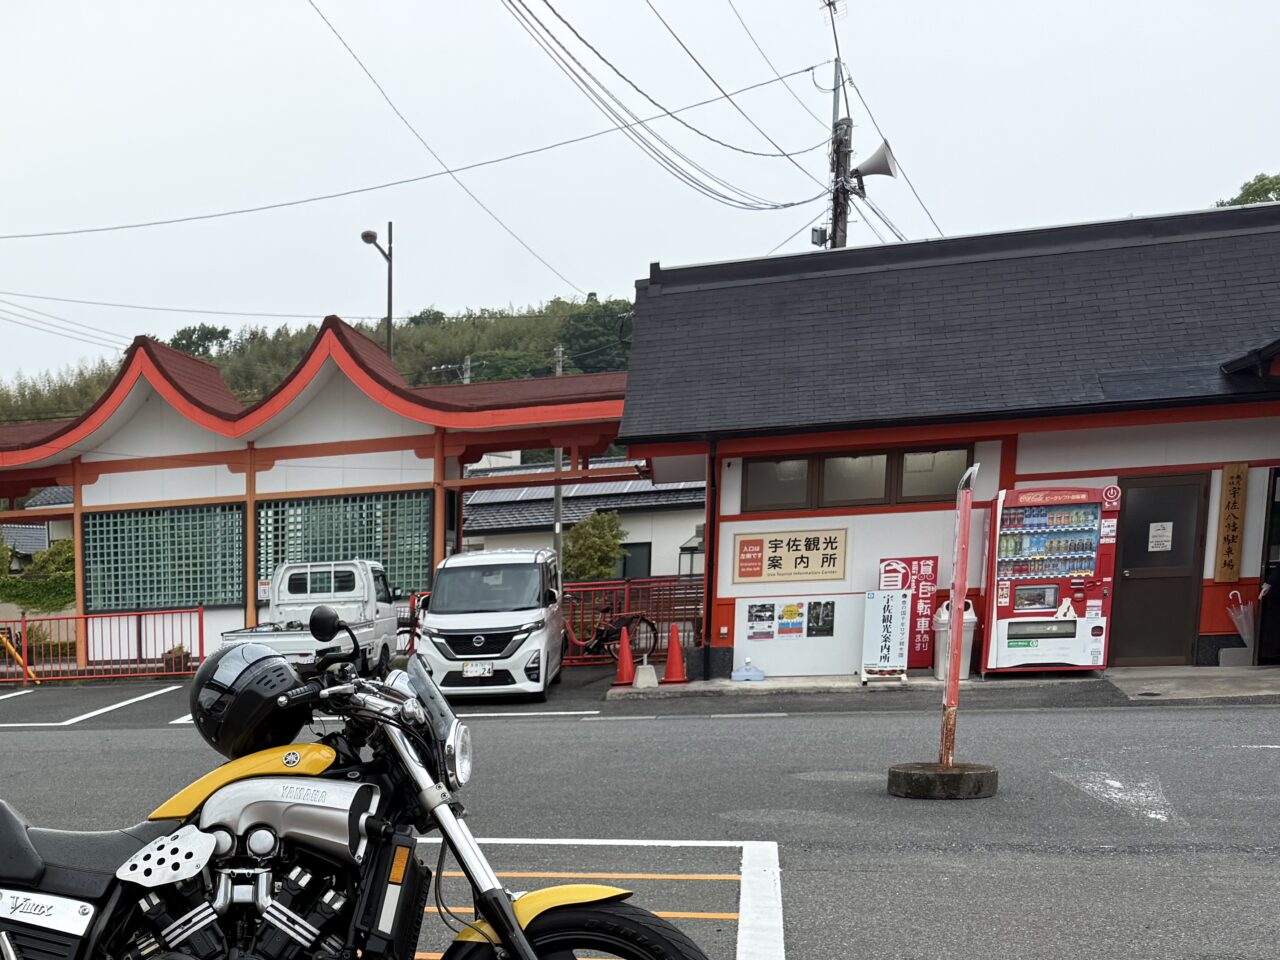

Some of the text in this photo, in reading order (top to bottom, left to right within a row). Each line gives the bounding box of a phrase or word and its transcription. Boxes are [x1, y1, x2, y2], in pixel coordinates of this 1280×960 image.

[768, 536, 838, 553] 宇佐観光
[767, 554, 837, 570] 案内所
[879, 594, 894, 663] 宇佐観光案内所
[281, 785, 327, 803] YAMAHA
